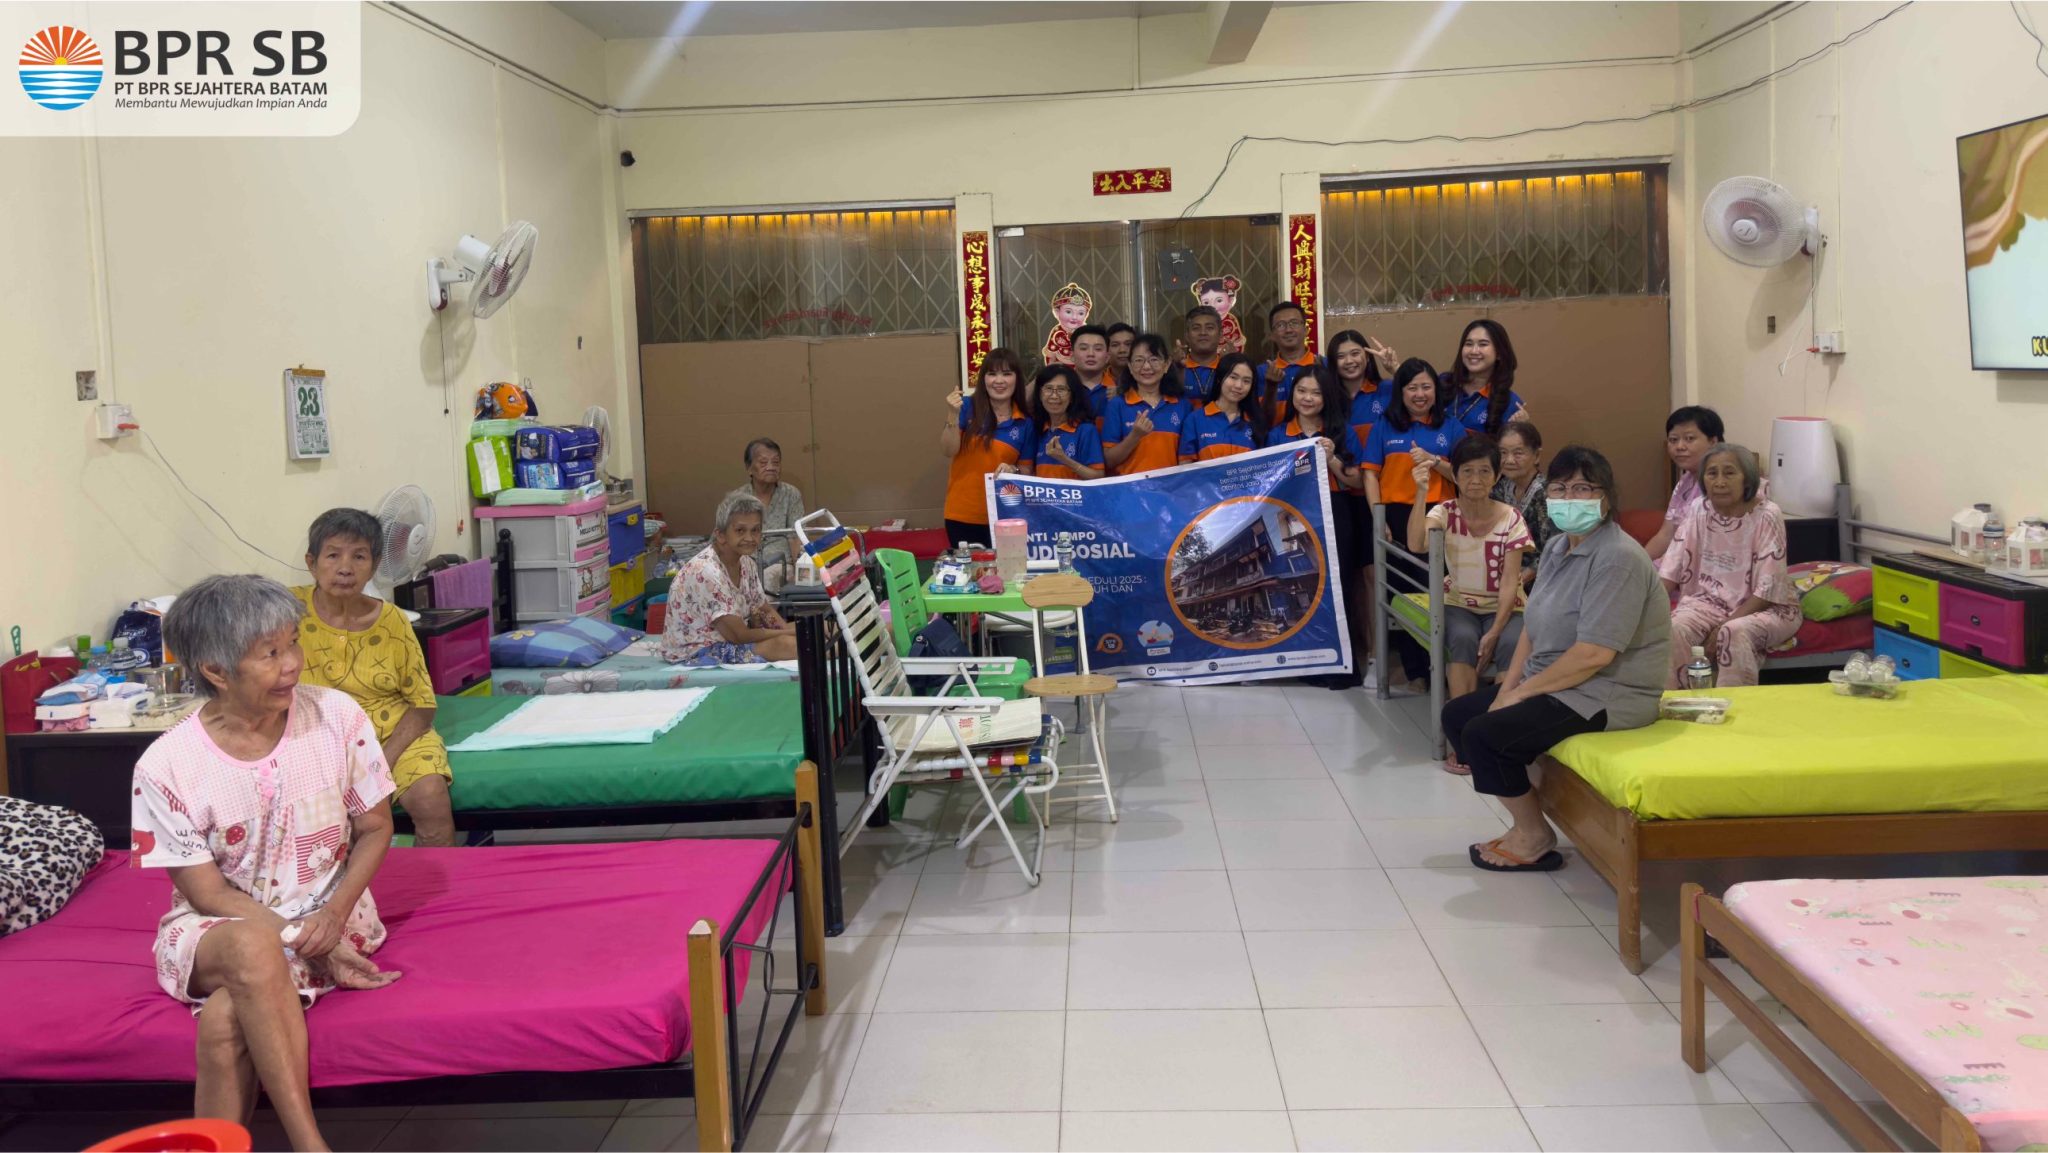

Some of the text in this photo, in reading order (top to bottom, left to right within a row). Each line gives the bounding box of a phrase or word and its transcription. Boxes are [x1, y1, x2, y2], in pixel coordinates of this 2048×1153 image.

[1099, 171, 1165, 192] 出入平安
[297, 386, 320, 417] 23
[1023, 485, 1082, 500] BPR SB
[1027, 531, 1096, 542] NTI JMPO
[1027, 545, 1058, 560] UDI
[1087, 576, 1117, 585] EDULI
[1093, 584, 1133, 593] UH DAN
